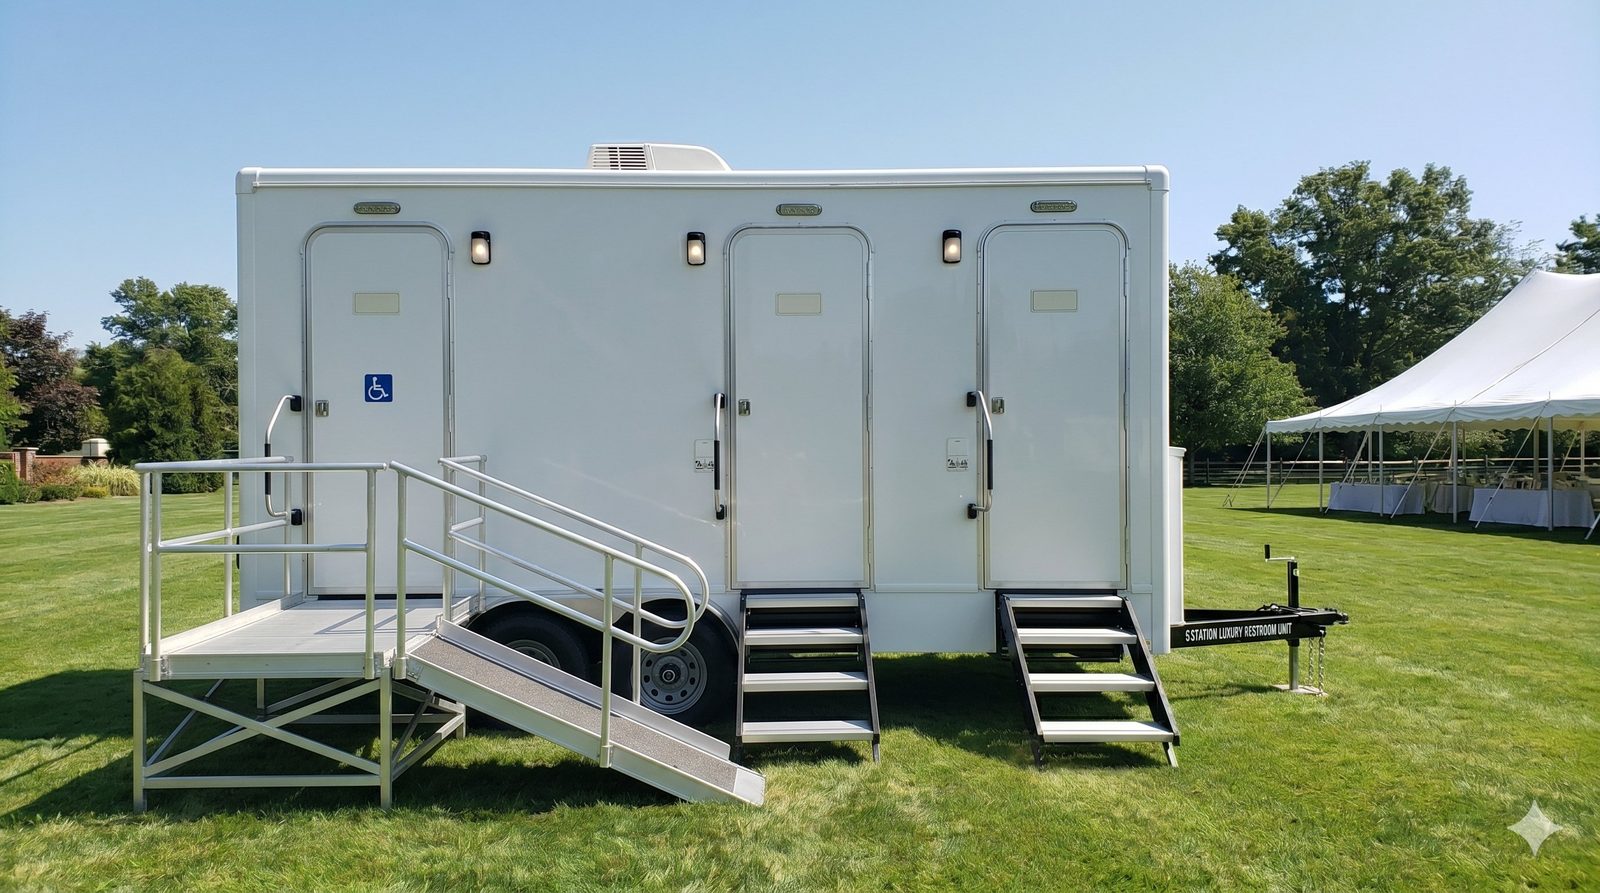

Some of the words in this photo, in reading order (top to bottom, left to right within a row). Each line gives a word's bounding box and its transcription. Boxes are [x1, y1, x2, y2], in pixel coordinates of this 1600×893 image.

[1219, 626, 1243, 639] LUXURY
[1244, 624, 1277, 637] RESTROOM
[1278, 622, 1292, 634] UNIT
